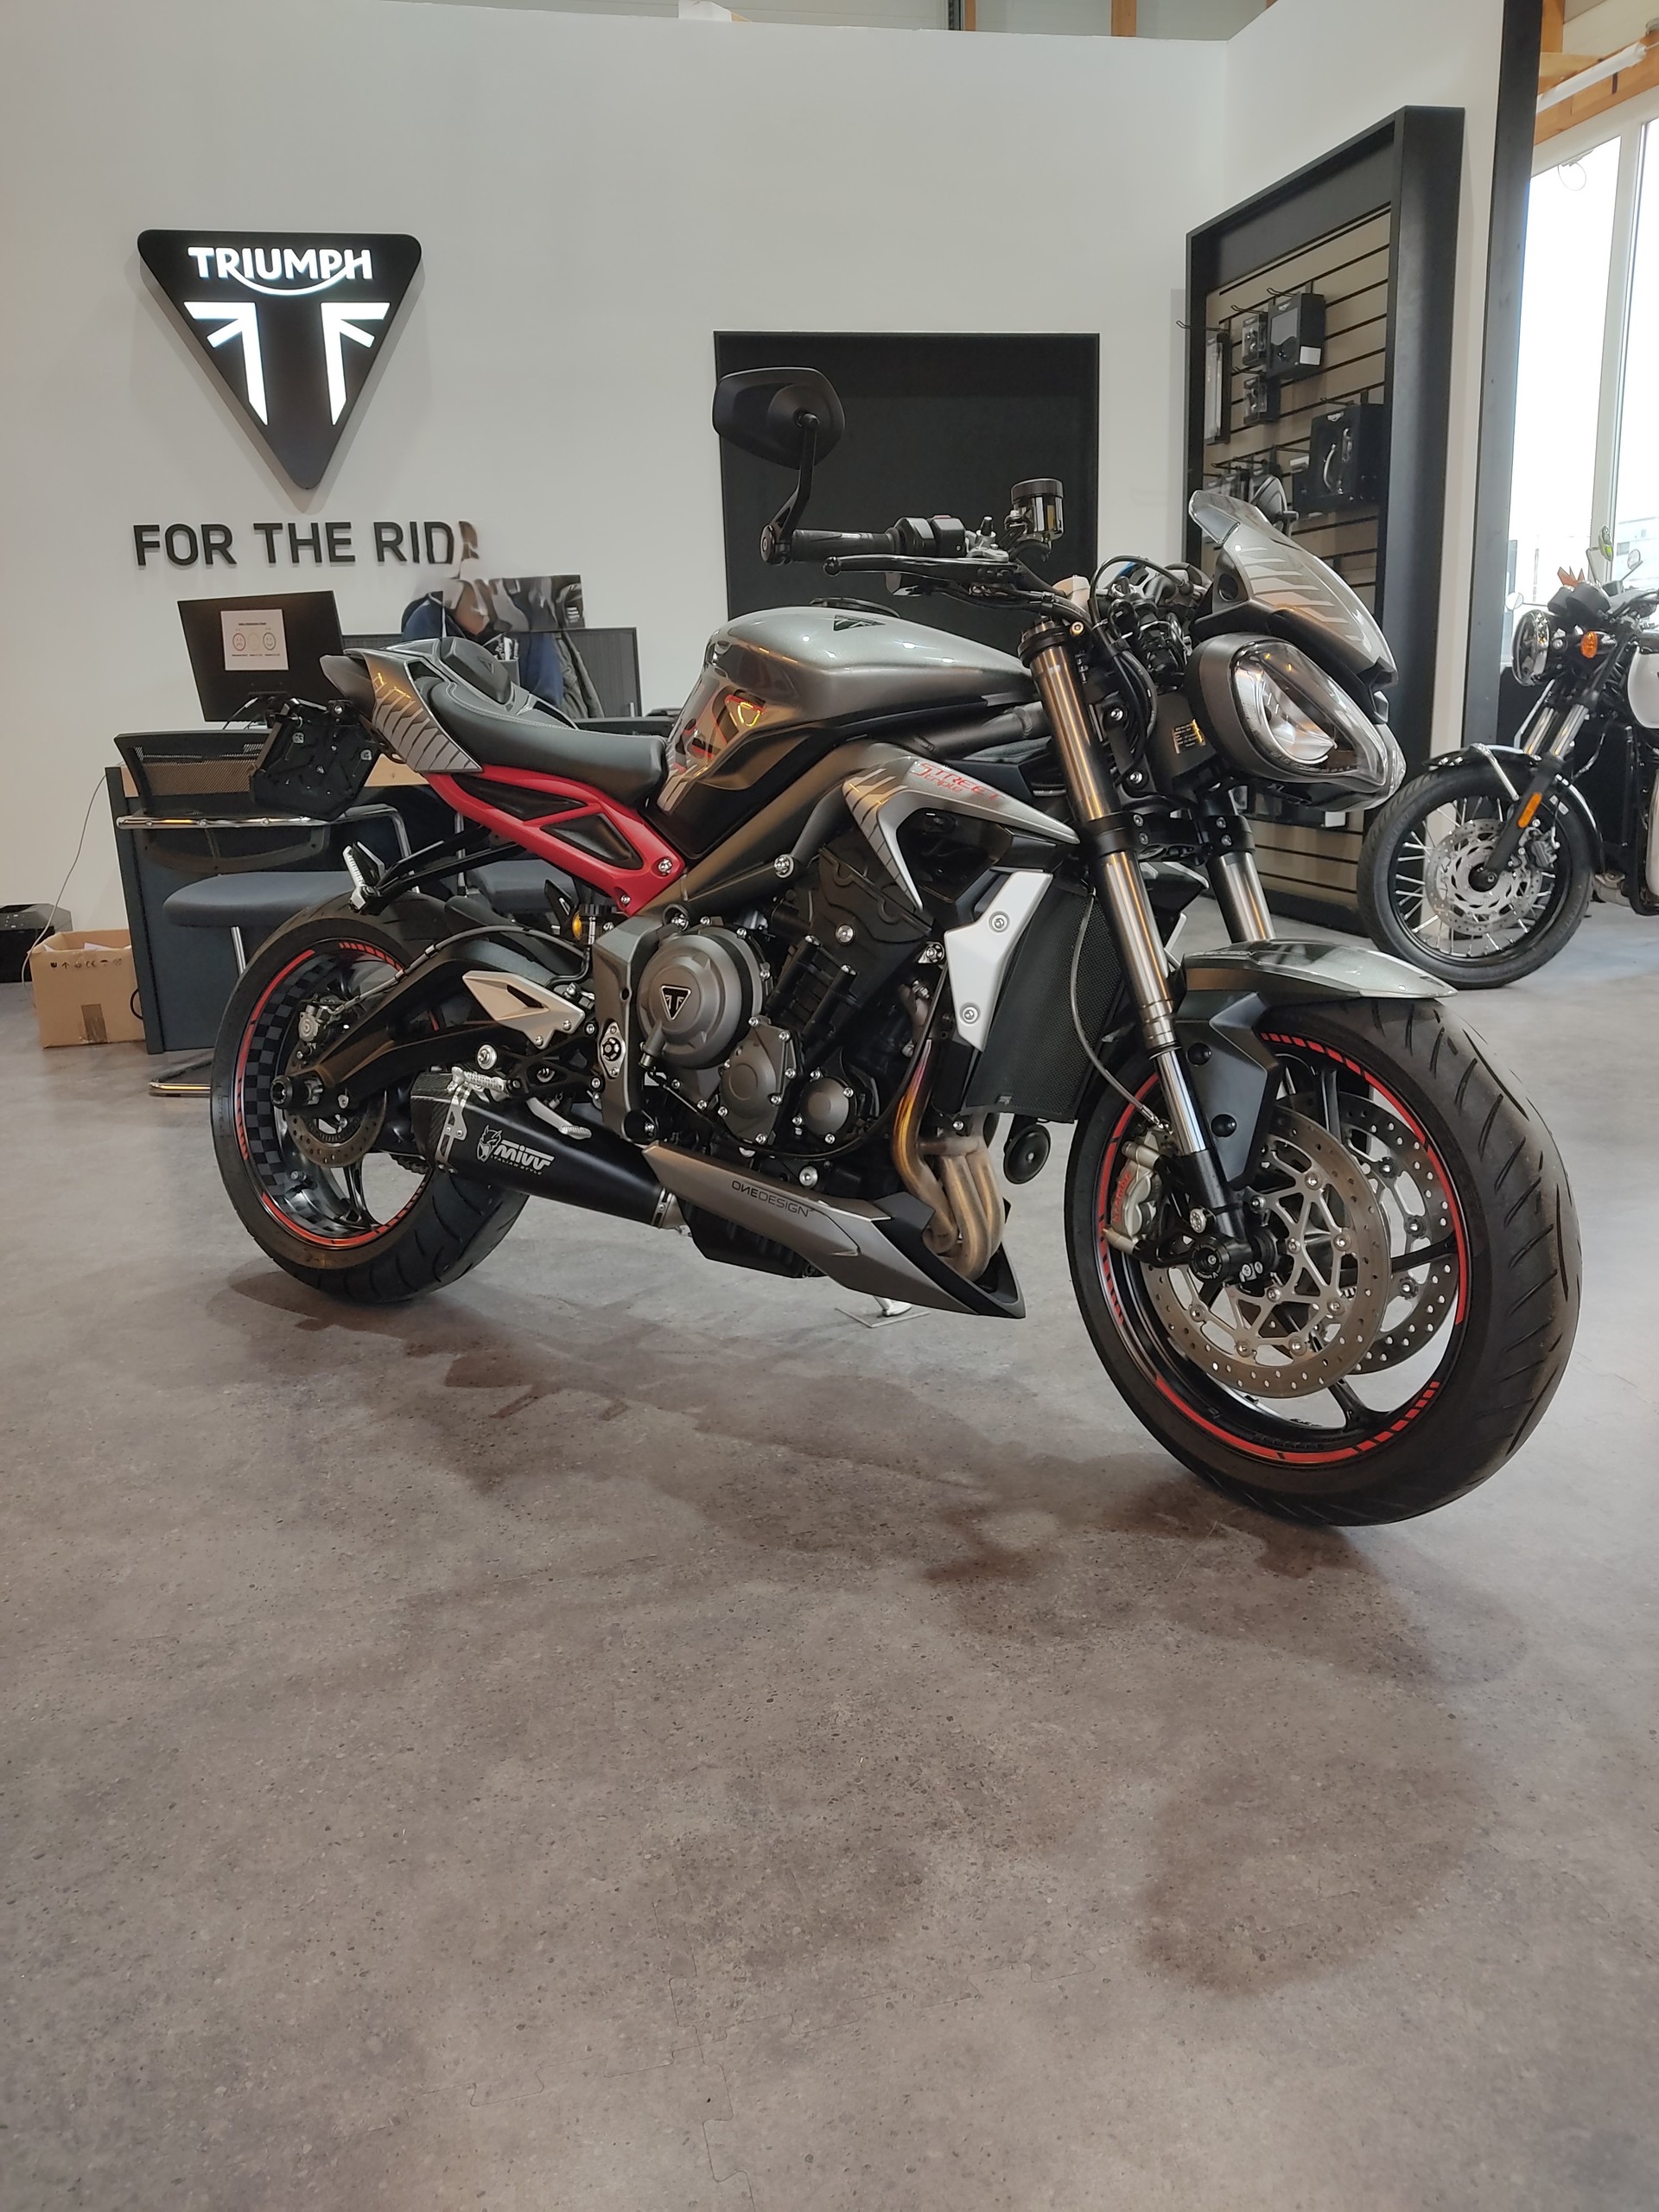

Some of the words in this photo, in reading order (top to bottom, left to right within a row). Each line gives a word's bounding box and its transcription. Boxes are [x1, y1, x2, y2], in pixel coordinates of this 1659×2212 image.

[188, 247, 373, 296] TRIUMPH
[133, 524, 238, 566] FOR
[253, 522, 356, 564] THE
[732, 1180, 809, 1217] ONEDESIGN
